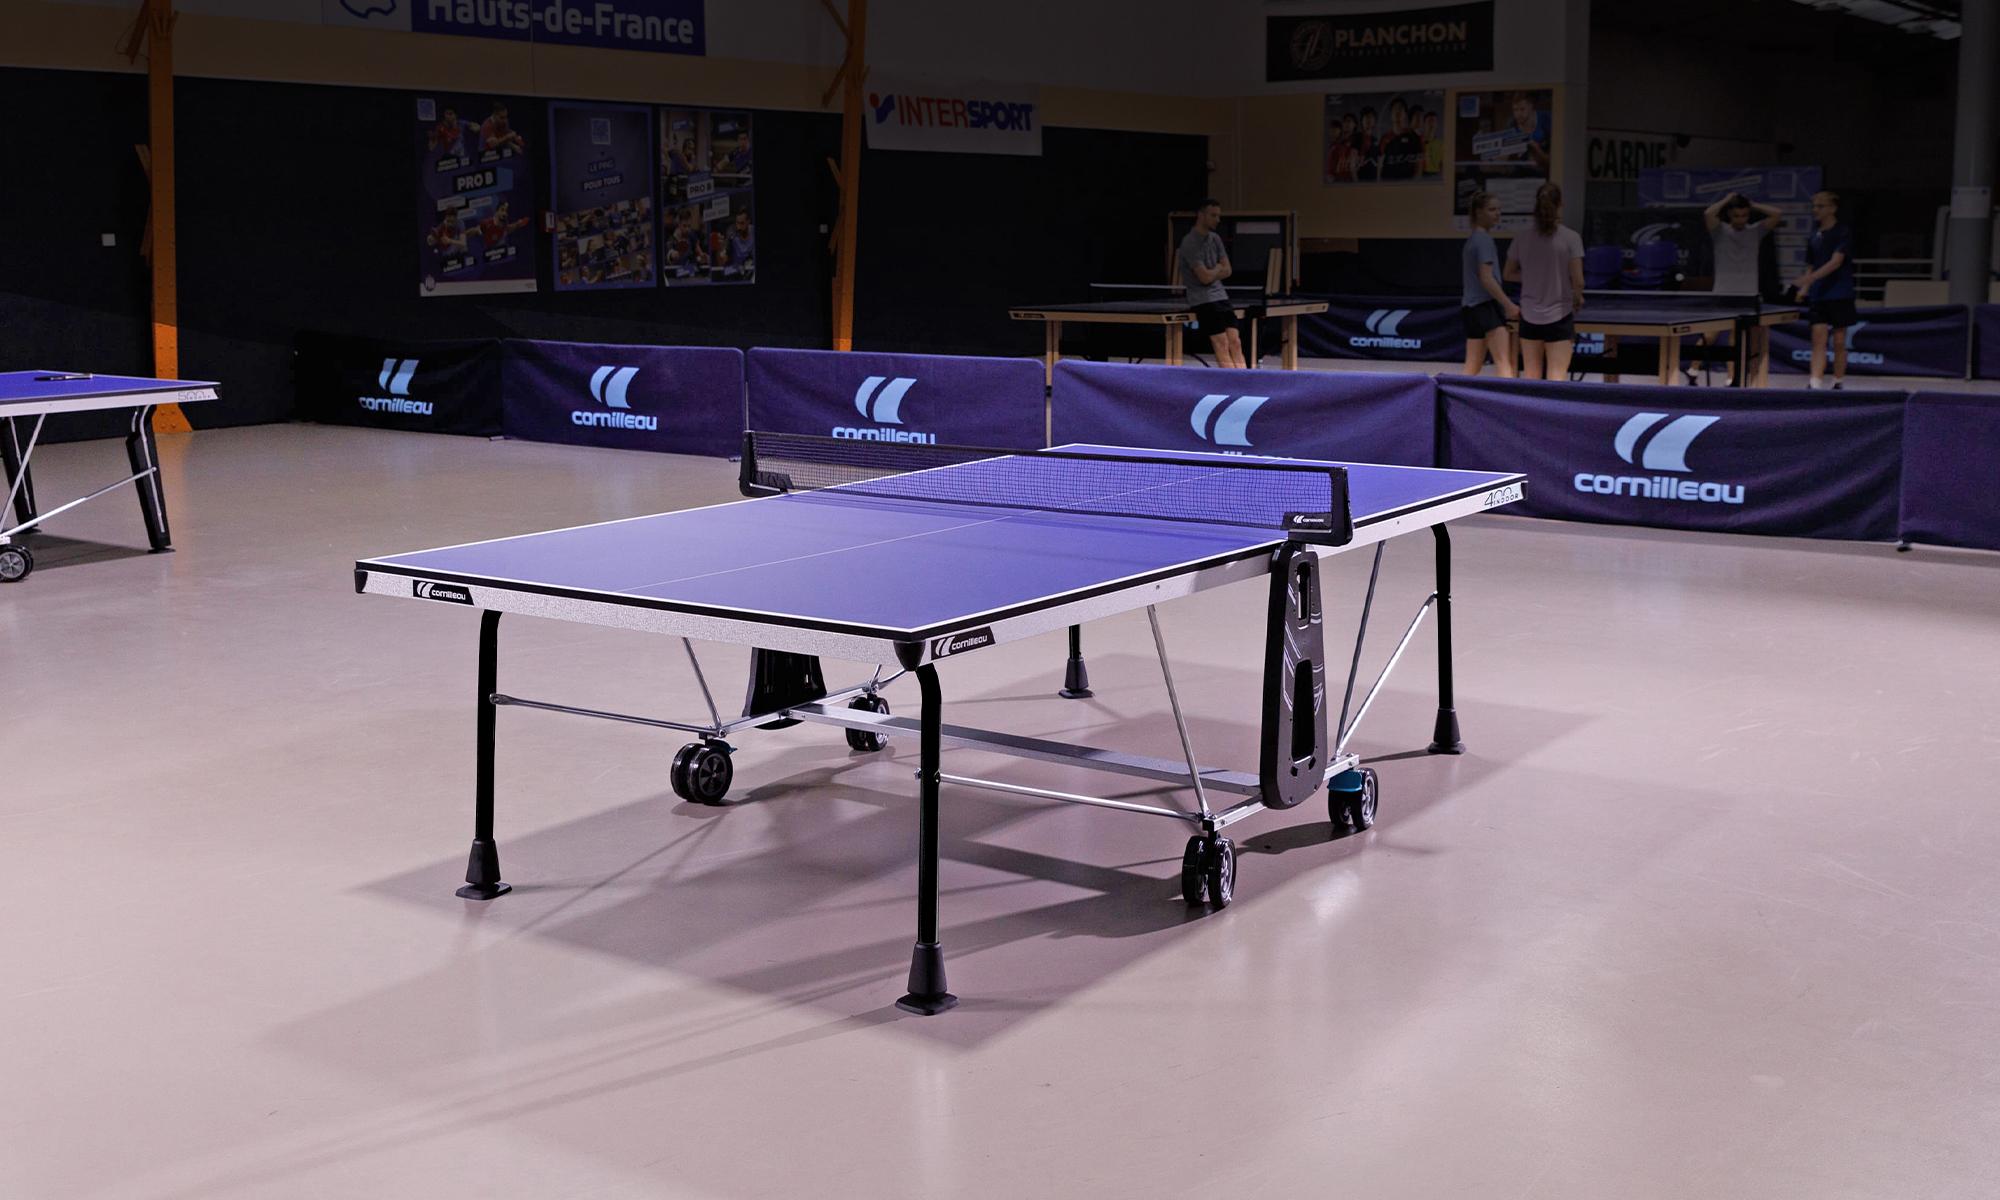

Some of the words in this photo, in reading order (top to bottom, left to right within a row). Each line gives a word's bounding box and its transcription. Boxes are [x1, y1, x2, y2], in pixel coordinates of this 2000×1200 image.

[427, 0, 694, 43] Hauts-de-France
[1335, 21, 1467, 48] PLANCHON
[898, 95, 1033, 131] INTERSPORT
[457, 173, 484, 191] PRO
[485, 171, 493, 185] B
[359, 397, 432, 415] cornilleau
[572, 411, 657, 430] cornilleau
[1574, 473, 1745, 504] cornilleau
[431, 589, 466, 600] cornilleau
[951, 635, 988, 650] cornilleau
